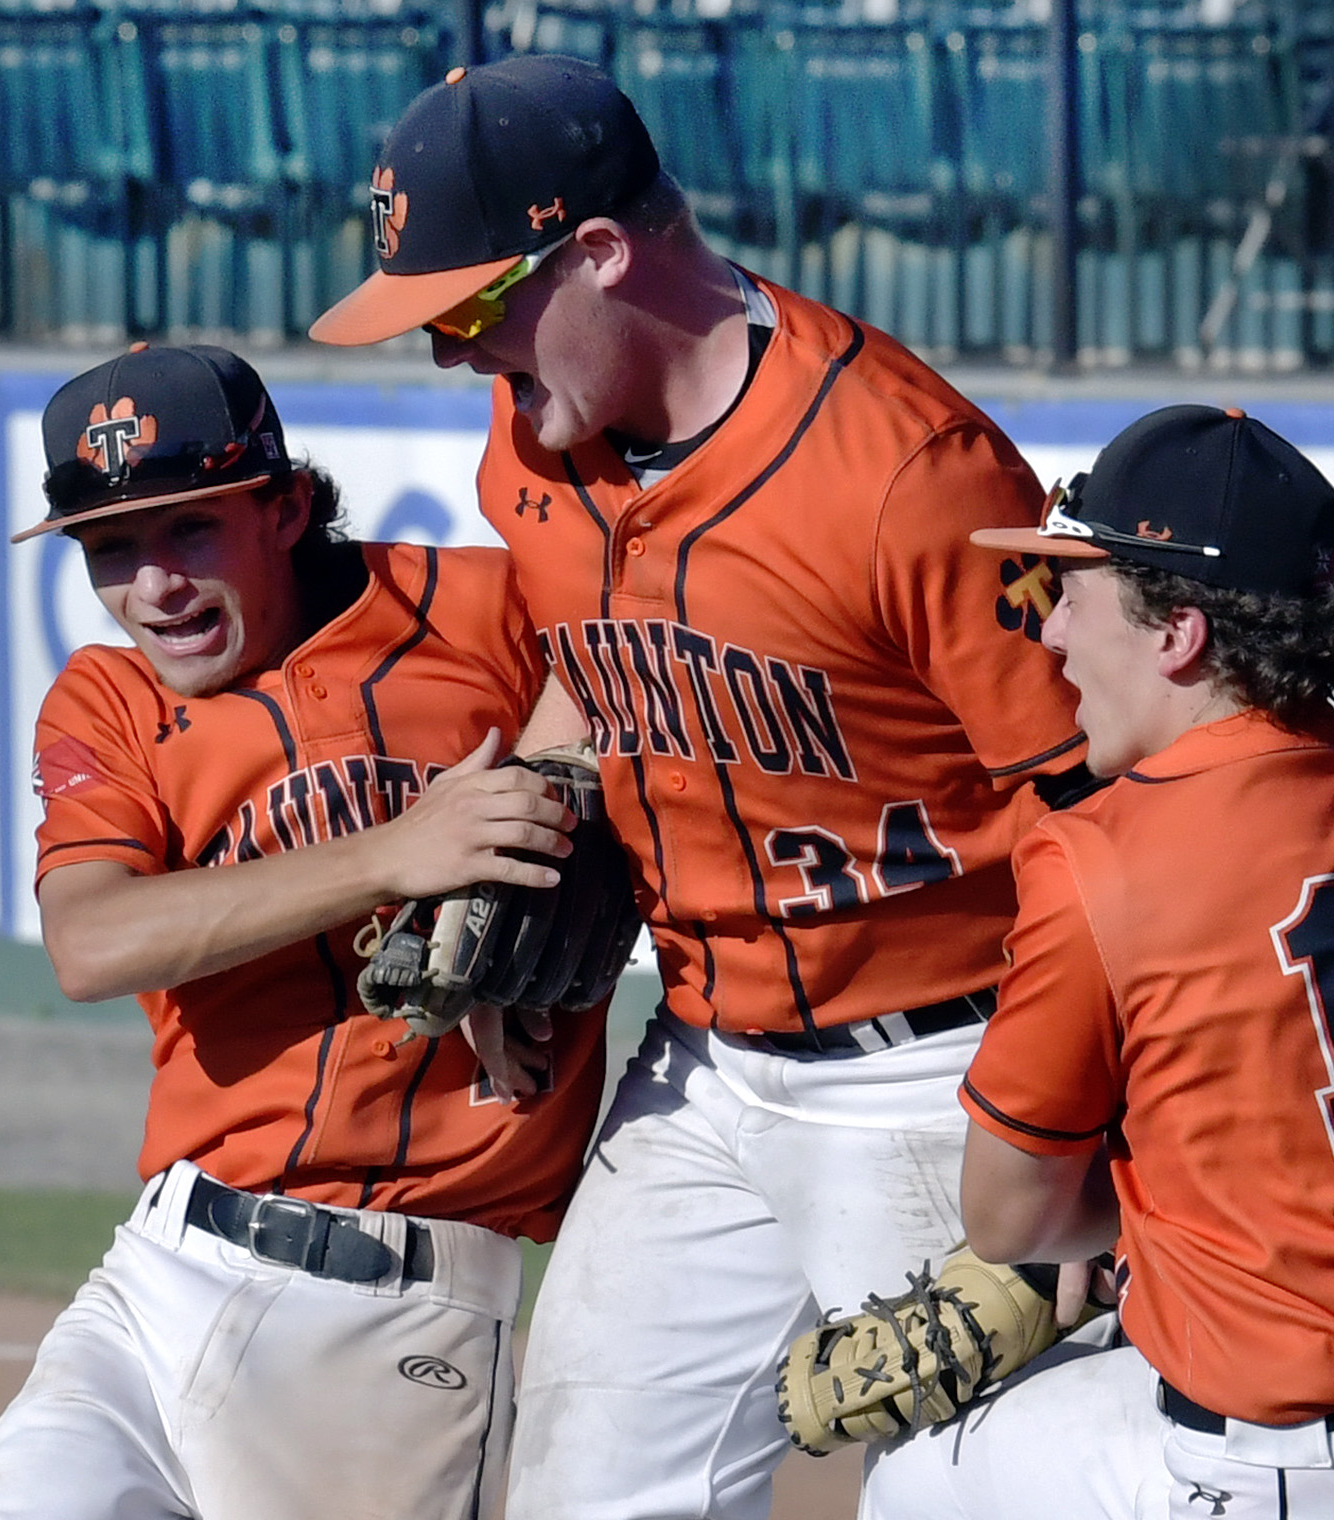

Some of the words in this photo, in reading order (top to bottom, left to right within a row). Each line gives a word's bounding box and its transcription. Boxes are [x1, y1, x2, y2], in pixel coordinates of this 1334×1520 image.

[86, 415, 141, 485] T
[1005, 562, 1054, 620] T
[193, 753, 455, 870] TAUNT
[765, 799, 964, 918] 34
